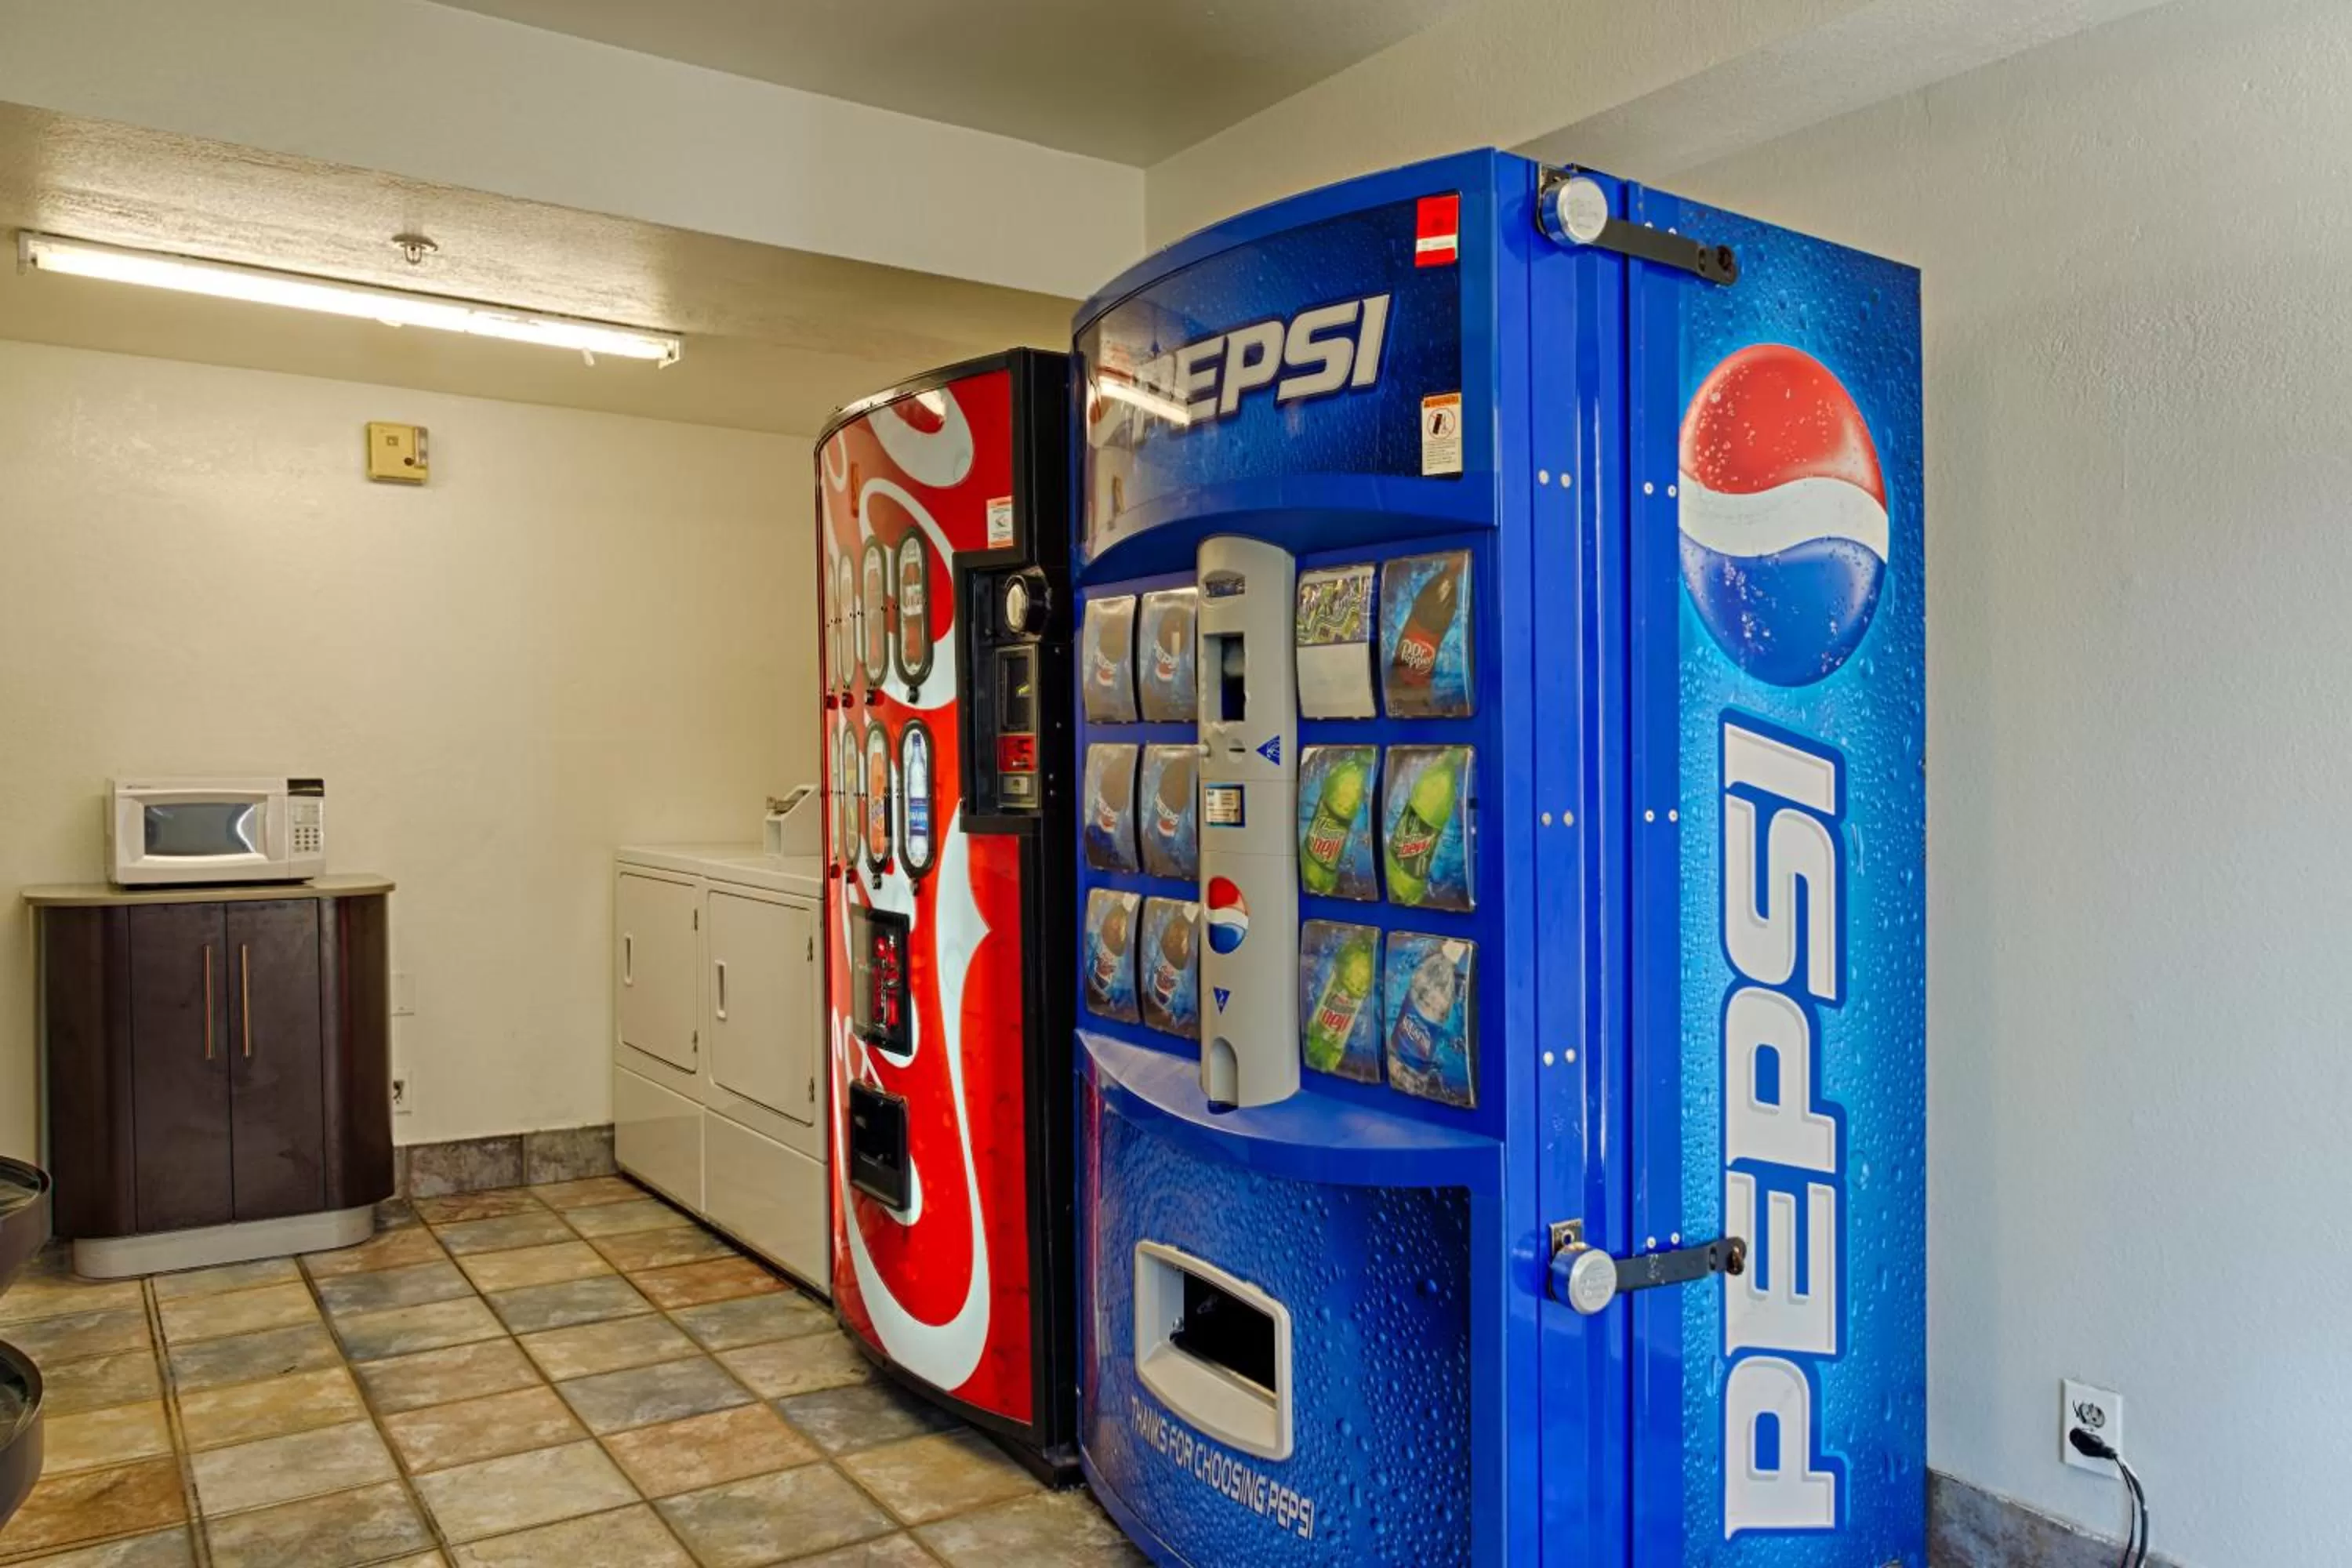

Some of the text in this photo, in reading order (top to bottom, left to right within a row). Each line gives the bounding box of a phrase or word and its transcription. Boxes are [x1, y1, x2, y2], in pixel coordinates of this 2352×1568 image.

[1724, 721, 1836, 1539] PEPSI
[1131, 1396, 1315, 1541] THANKS FOR CHOOSING PEPSI
